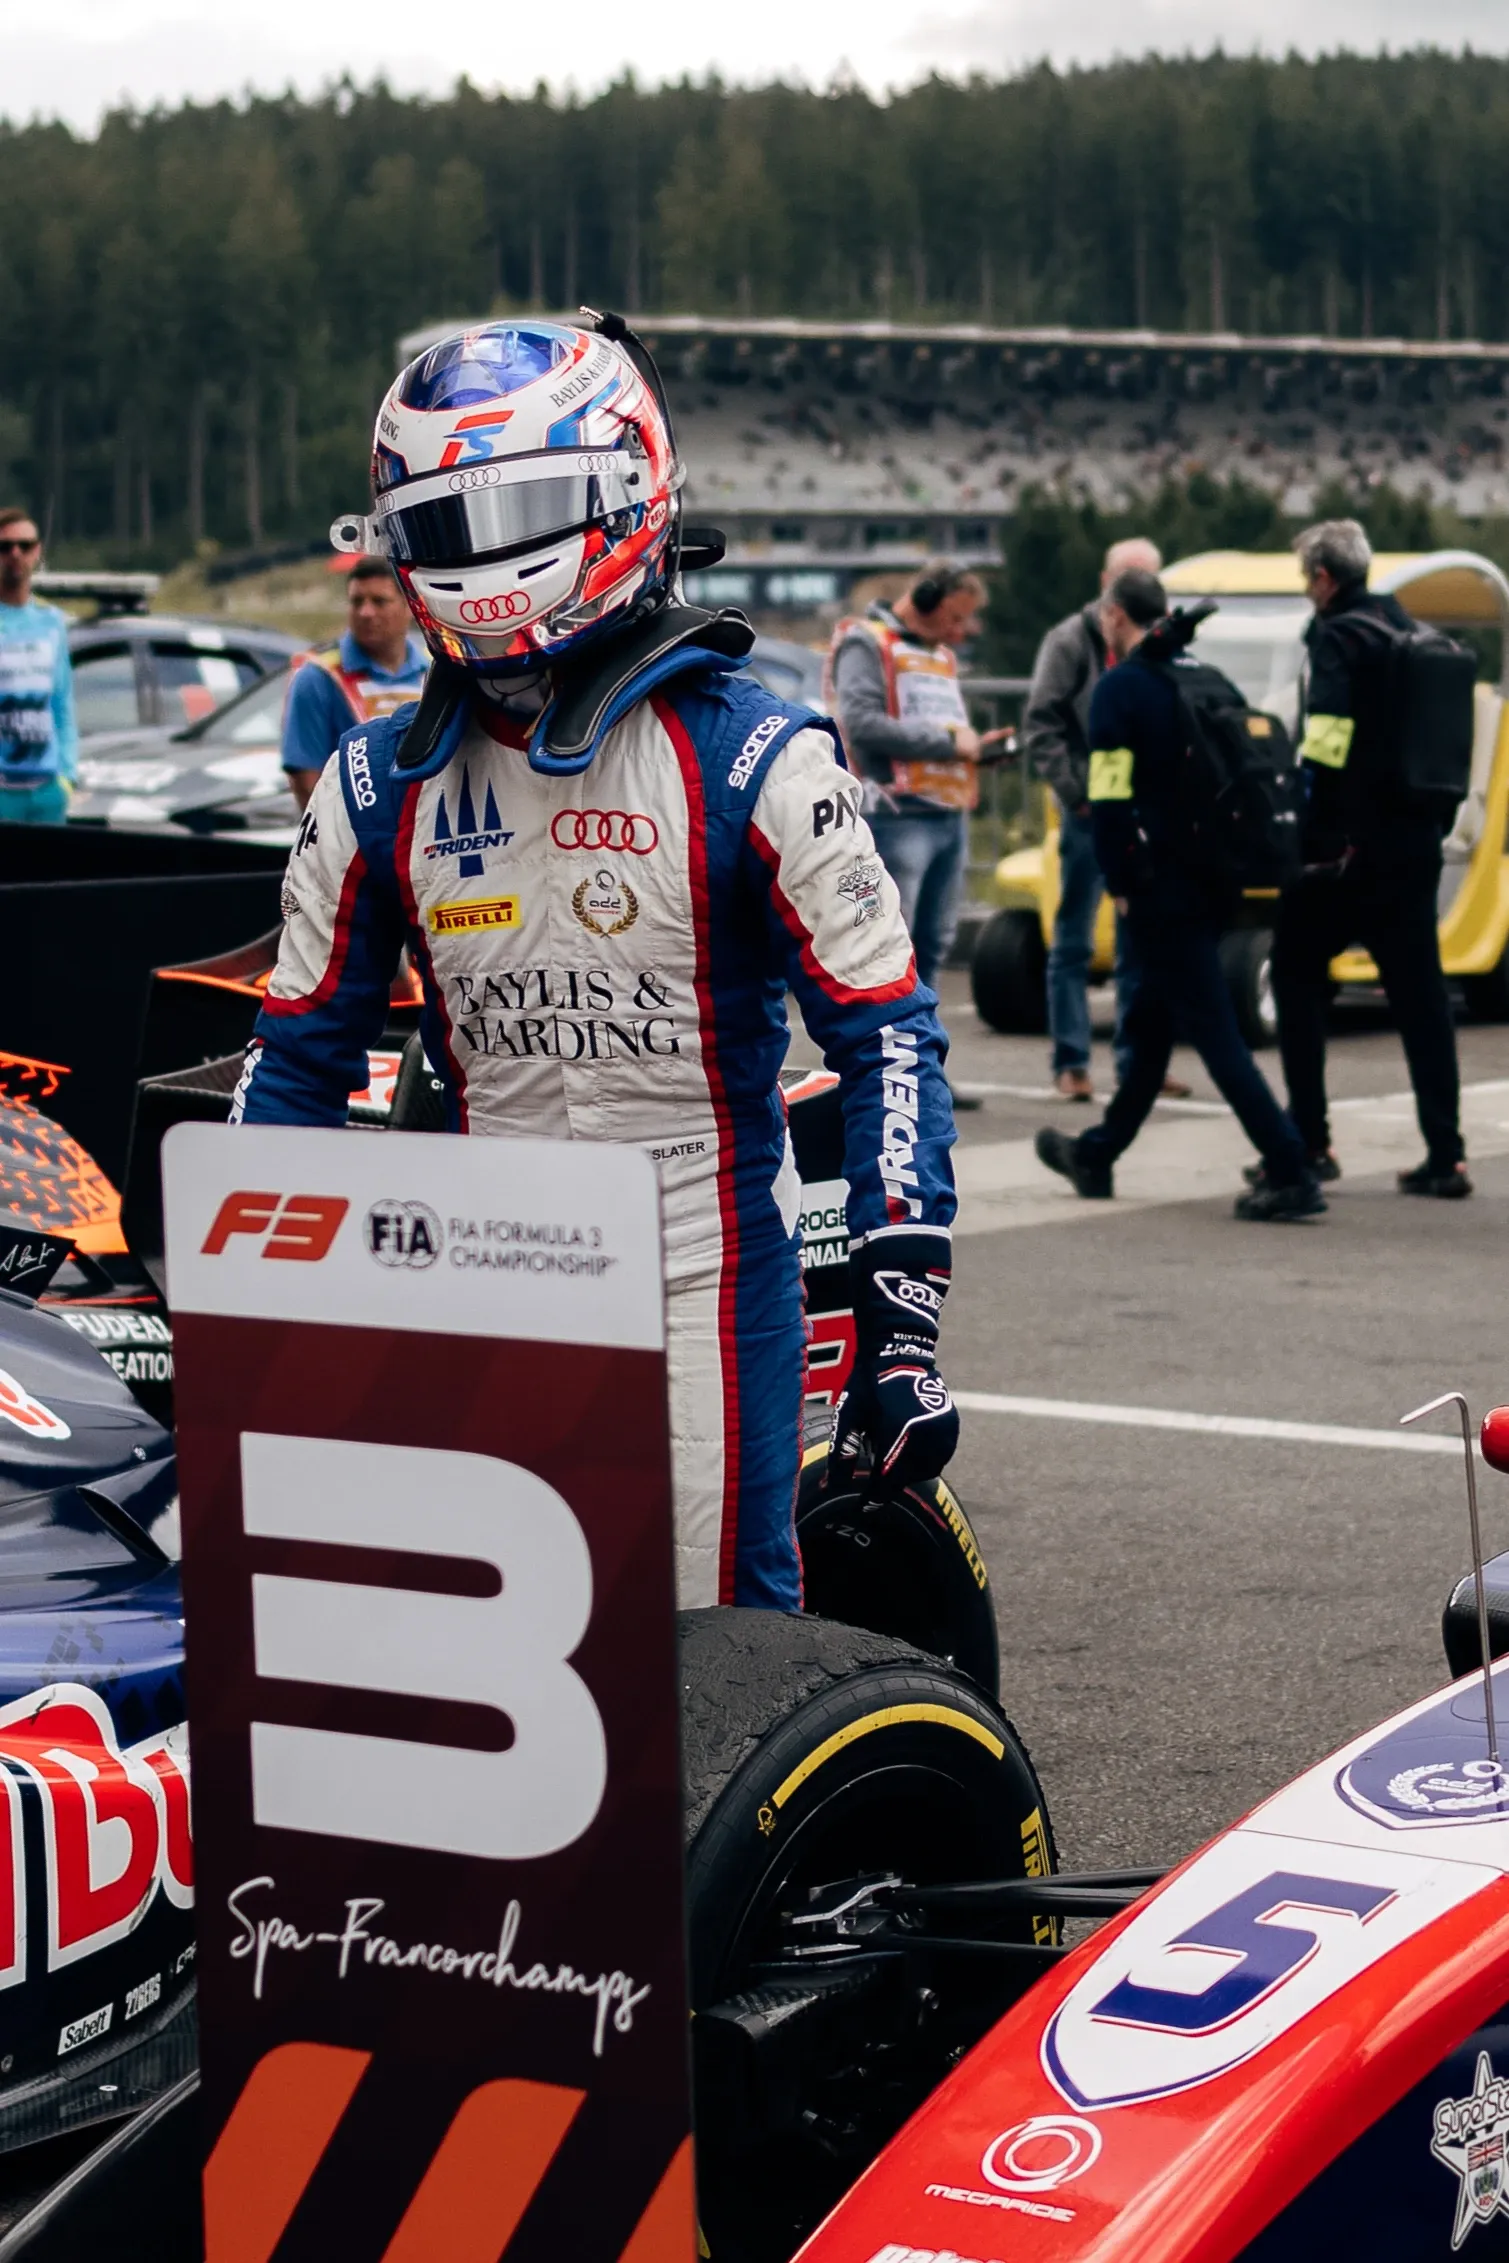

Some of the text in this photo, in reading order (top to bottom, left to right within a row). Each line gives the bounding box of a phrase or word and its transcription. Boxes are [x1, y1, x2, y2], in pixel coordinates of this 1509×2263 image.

[349, 736, 377, 810] sparco
[728, 715, 787, 789] sparco
[424, 832, 515, 860] TRIDENT
[435, 901, 513, 930] PIRELLI
[450, 969, 676, 1016] BAYLIS &
[457, 1014, 681, 1061] HARDING
[652, 1141, 706, 1161] SLATER
[200, 1190, 350, 1262] F3
[449, 1217, 478, 1241] FIA
[483, 1220, 586, 1246] FORMULA
[589, 1226, 603, 1249] 3
[241, 1432, 607, 1860] 3
[227, 1876, 651, 2055] Spa-Francorchamps
[1087, 1871, 1402, 2037] 5
[64, 2010, 107, 2049] Sabelt
[924, 2183, 1076, 2223] MEGARIDE
